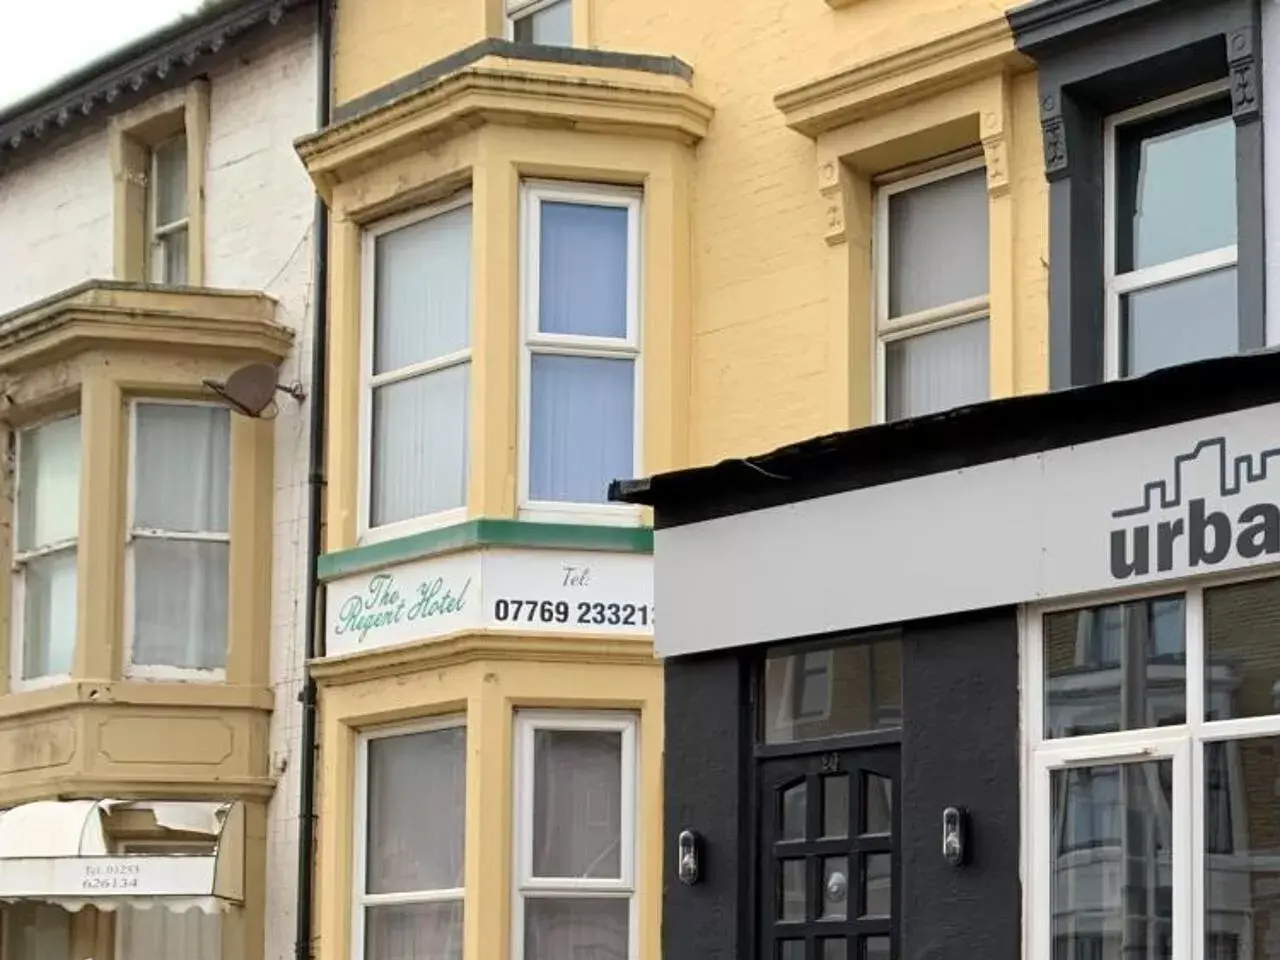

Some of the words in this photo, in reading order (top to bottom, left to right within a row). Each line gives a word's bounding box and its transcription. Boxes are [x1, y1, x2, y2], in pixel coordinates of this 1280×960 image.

[365, 573, 400, 610] The
[335, 595, 405, 643] Regent
[407, 576, 472, 621] Hotel
[494, 599, 570, 623] 07769
[577, 601, 655, 626] 23321
[82, 877, 138, 889] 626134
